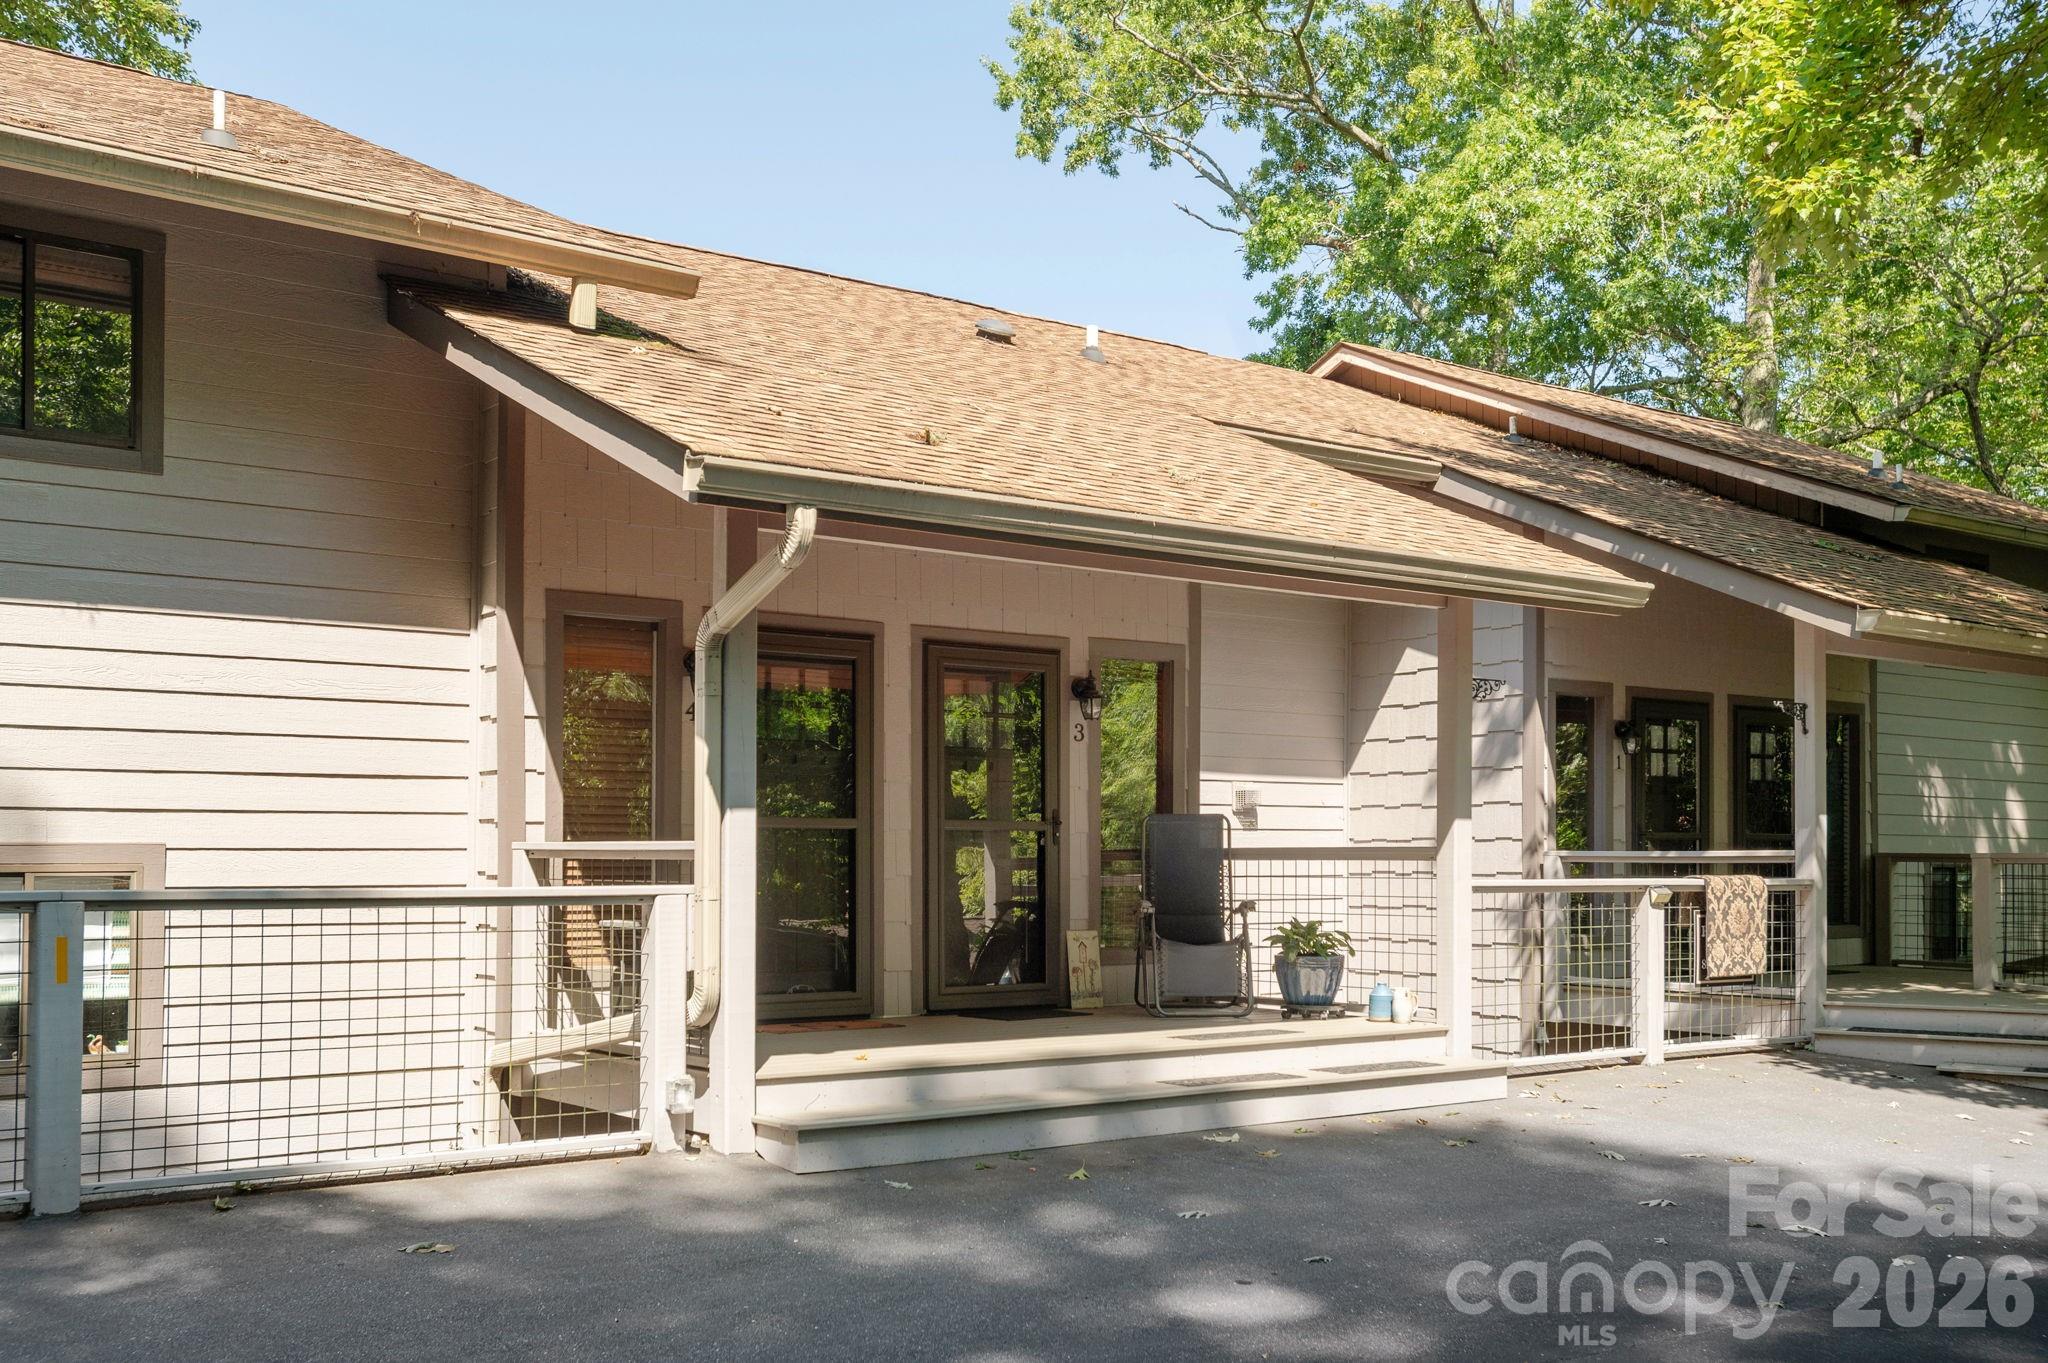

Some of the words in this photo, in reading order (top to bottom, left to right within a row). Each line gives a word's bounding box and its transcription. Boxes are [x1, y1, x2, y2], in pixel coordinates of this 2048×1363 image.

[684, 702, 696, 721] 4
[1073, 723, 1085, 742] 3
[1616, 755, 1622, 770] 1
